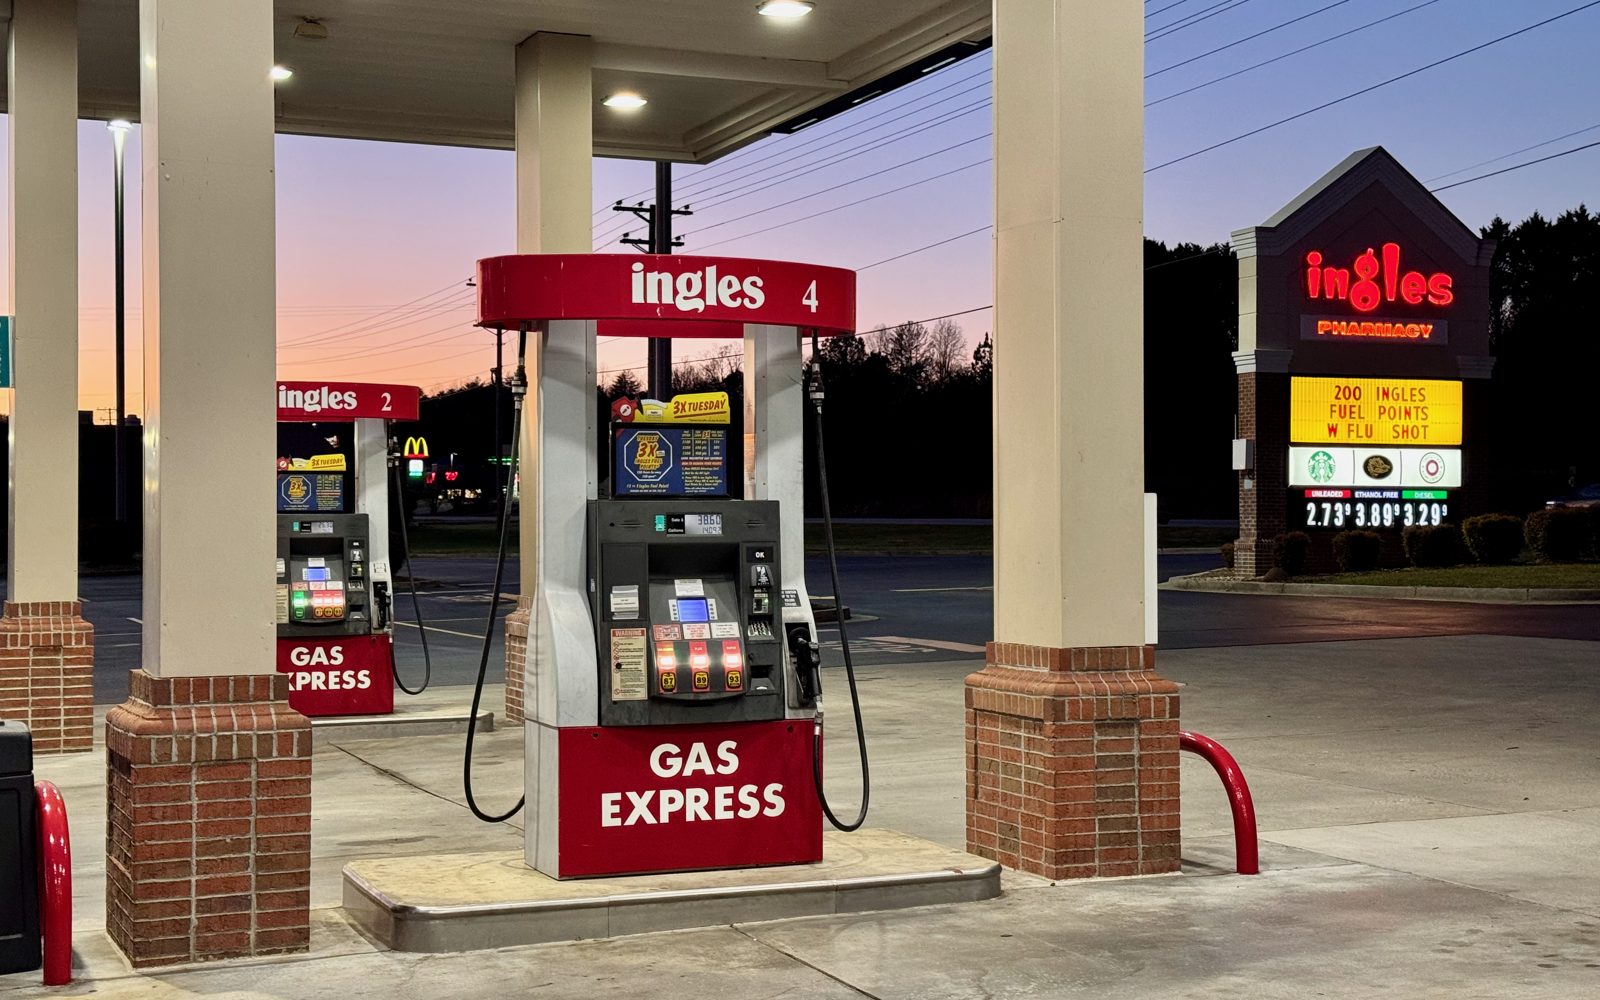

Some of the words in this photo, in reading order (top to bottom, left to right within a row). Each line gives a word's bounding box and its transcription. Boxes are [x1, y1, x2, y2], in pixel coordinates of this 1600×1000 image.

[1307, 243, 1453, 311] ingles
[632, 262, 765, 313] ingles
[802, 279, 819, 313] 4
[1317, 320, 1434, 339] PHARMACY
[279, 385, 357, 412] ingles
[381, 392, 392, 412] 2
[1334, 385, 1362, 401] 200
[1376, 387, 1426, 402] INGLES
[673, 401, 687, 415] 3X
[688, 400, 726, 412] TUESDAY
[1330, 404, 1365, 420] FUEL
[1378, 406, 1429, 421] POINTS
[1327, 423, 1338, 438] W
[1347, 424, 1373, 438] FLU
[1392, 425, 1429, 440] SHOT
[638, 442, 658, 458] 3X
[320, 458, 343, 466] TUESDAY
[1311, 490, 1344, 498] UNLEADED
[1354, 491, 1382, 499] ETHANOL
[1383, 491, 1399, 499] FREE
[290, 646, 343, 666] GAS
[288, 670, 371, 691] XPRESS
[663, 677, 674, 685] 87
[696, 676, 707, 684] 89
[729, 675, 740, 683] 93
[649, 740, 739, 778] GAS
[601, 783, 786, 827] EXPRESS
